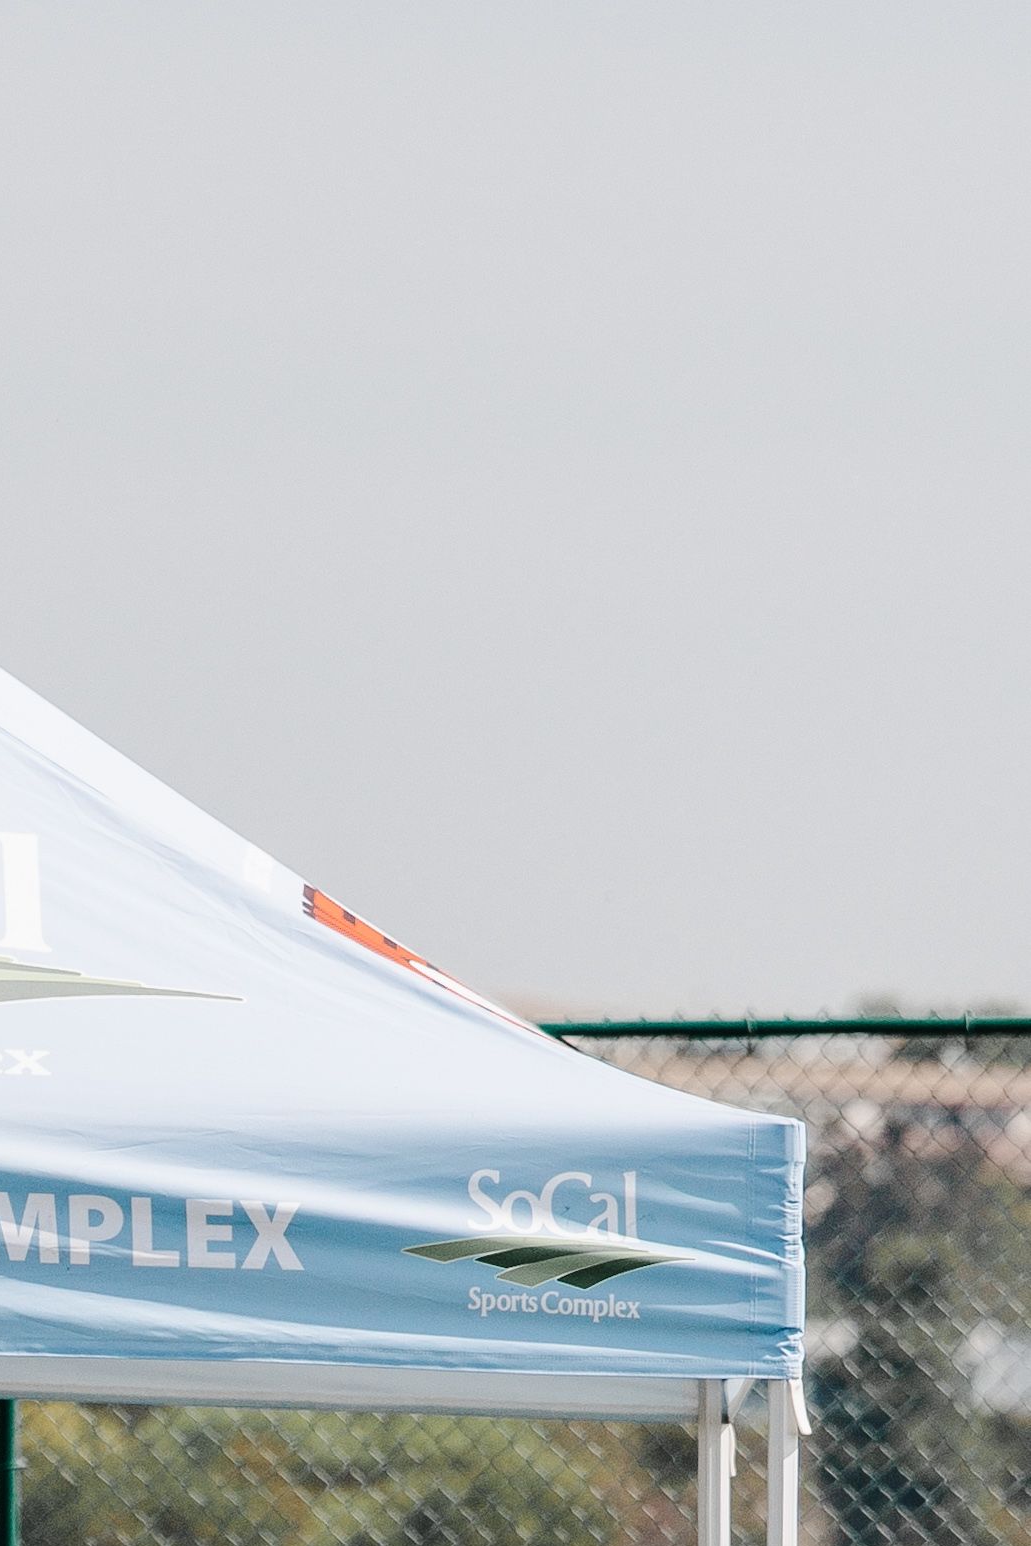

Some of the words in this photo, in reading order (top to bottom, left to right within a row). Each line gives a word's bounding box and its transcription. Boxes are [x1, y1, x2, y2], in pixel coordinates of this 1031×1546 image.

[467, 1169, 638, 1242] SoCal
[467, 1286, 538, 1317] Sports
[540, 1291, 640, 1323] Complex
